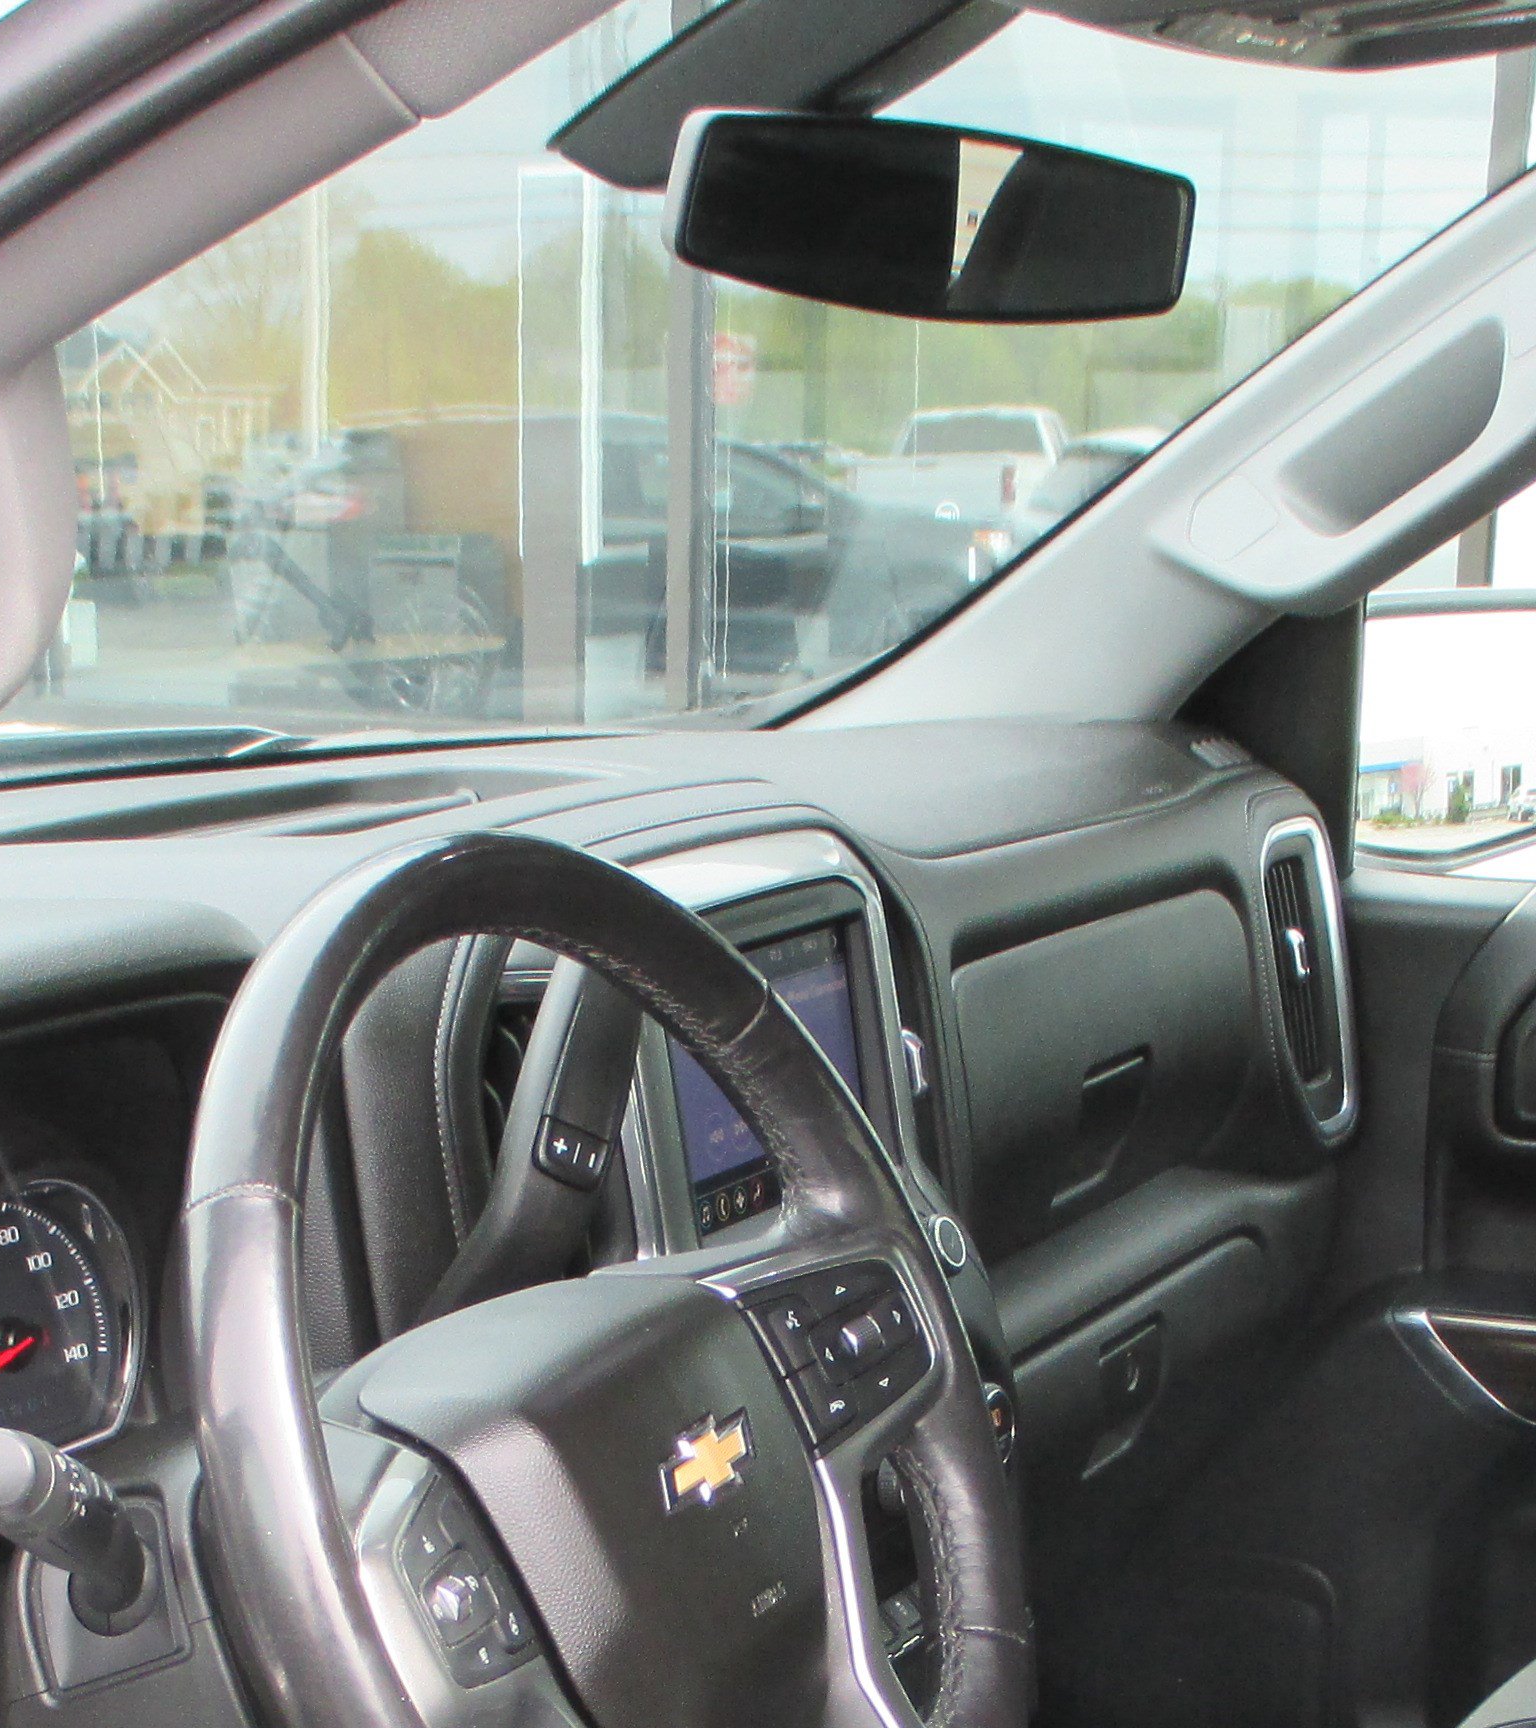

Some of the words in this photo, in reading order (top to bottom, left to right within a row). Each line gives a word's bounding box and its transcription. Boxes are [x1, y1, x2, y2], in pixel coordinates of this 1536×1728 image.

[27, 1251, 53, 1272] 100
[55, 1290, 79, 1311] 120
[64, 1343, 89, 1364] 140
